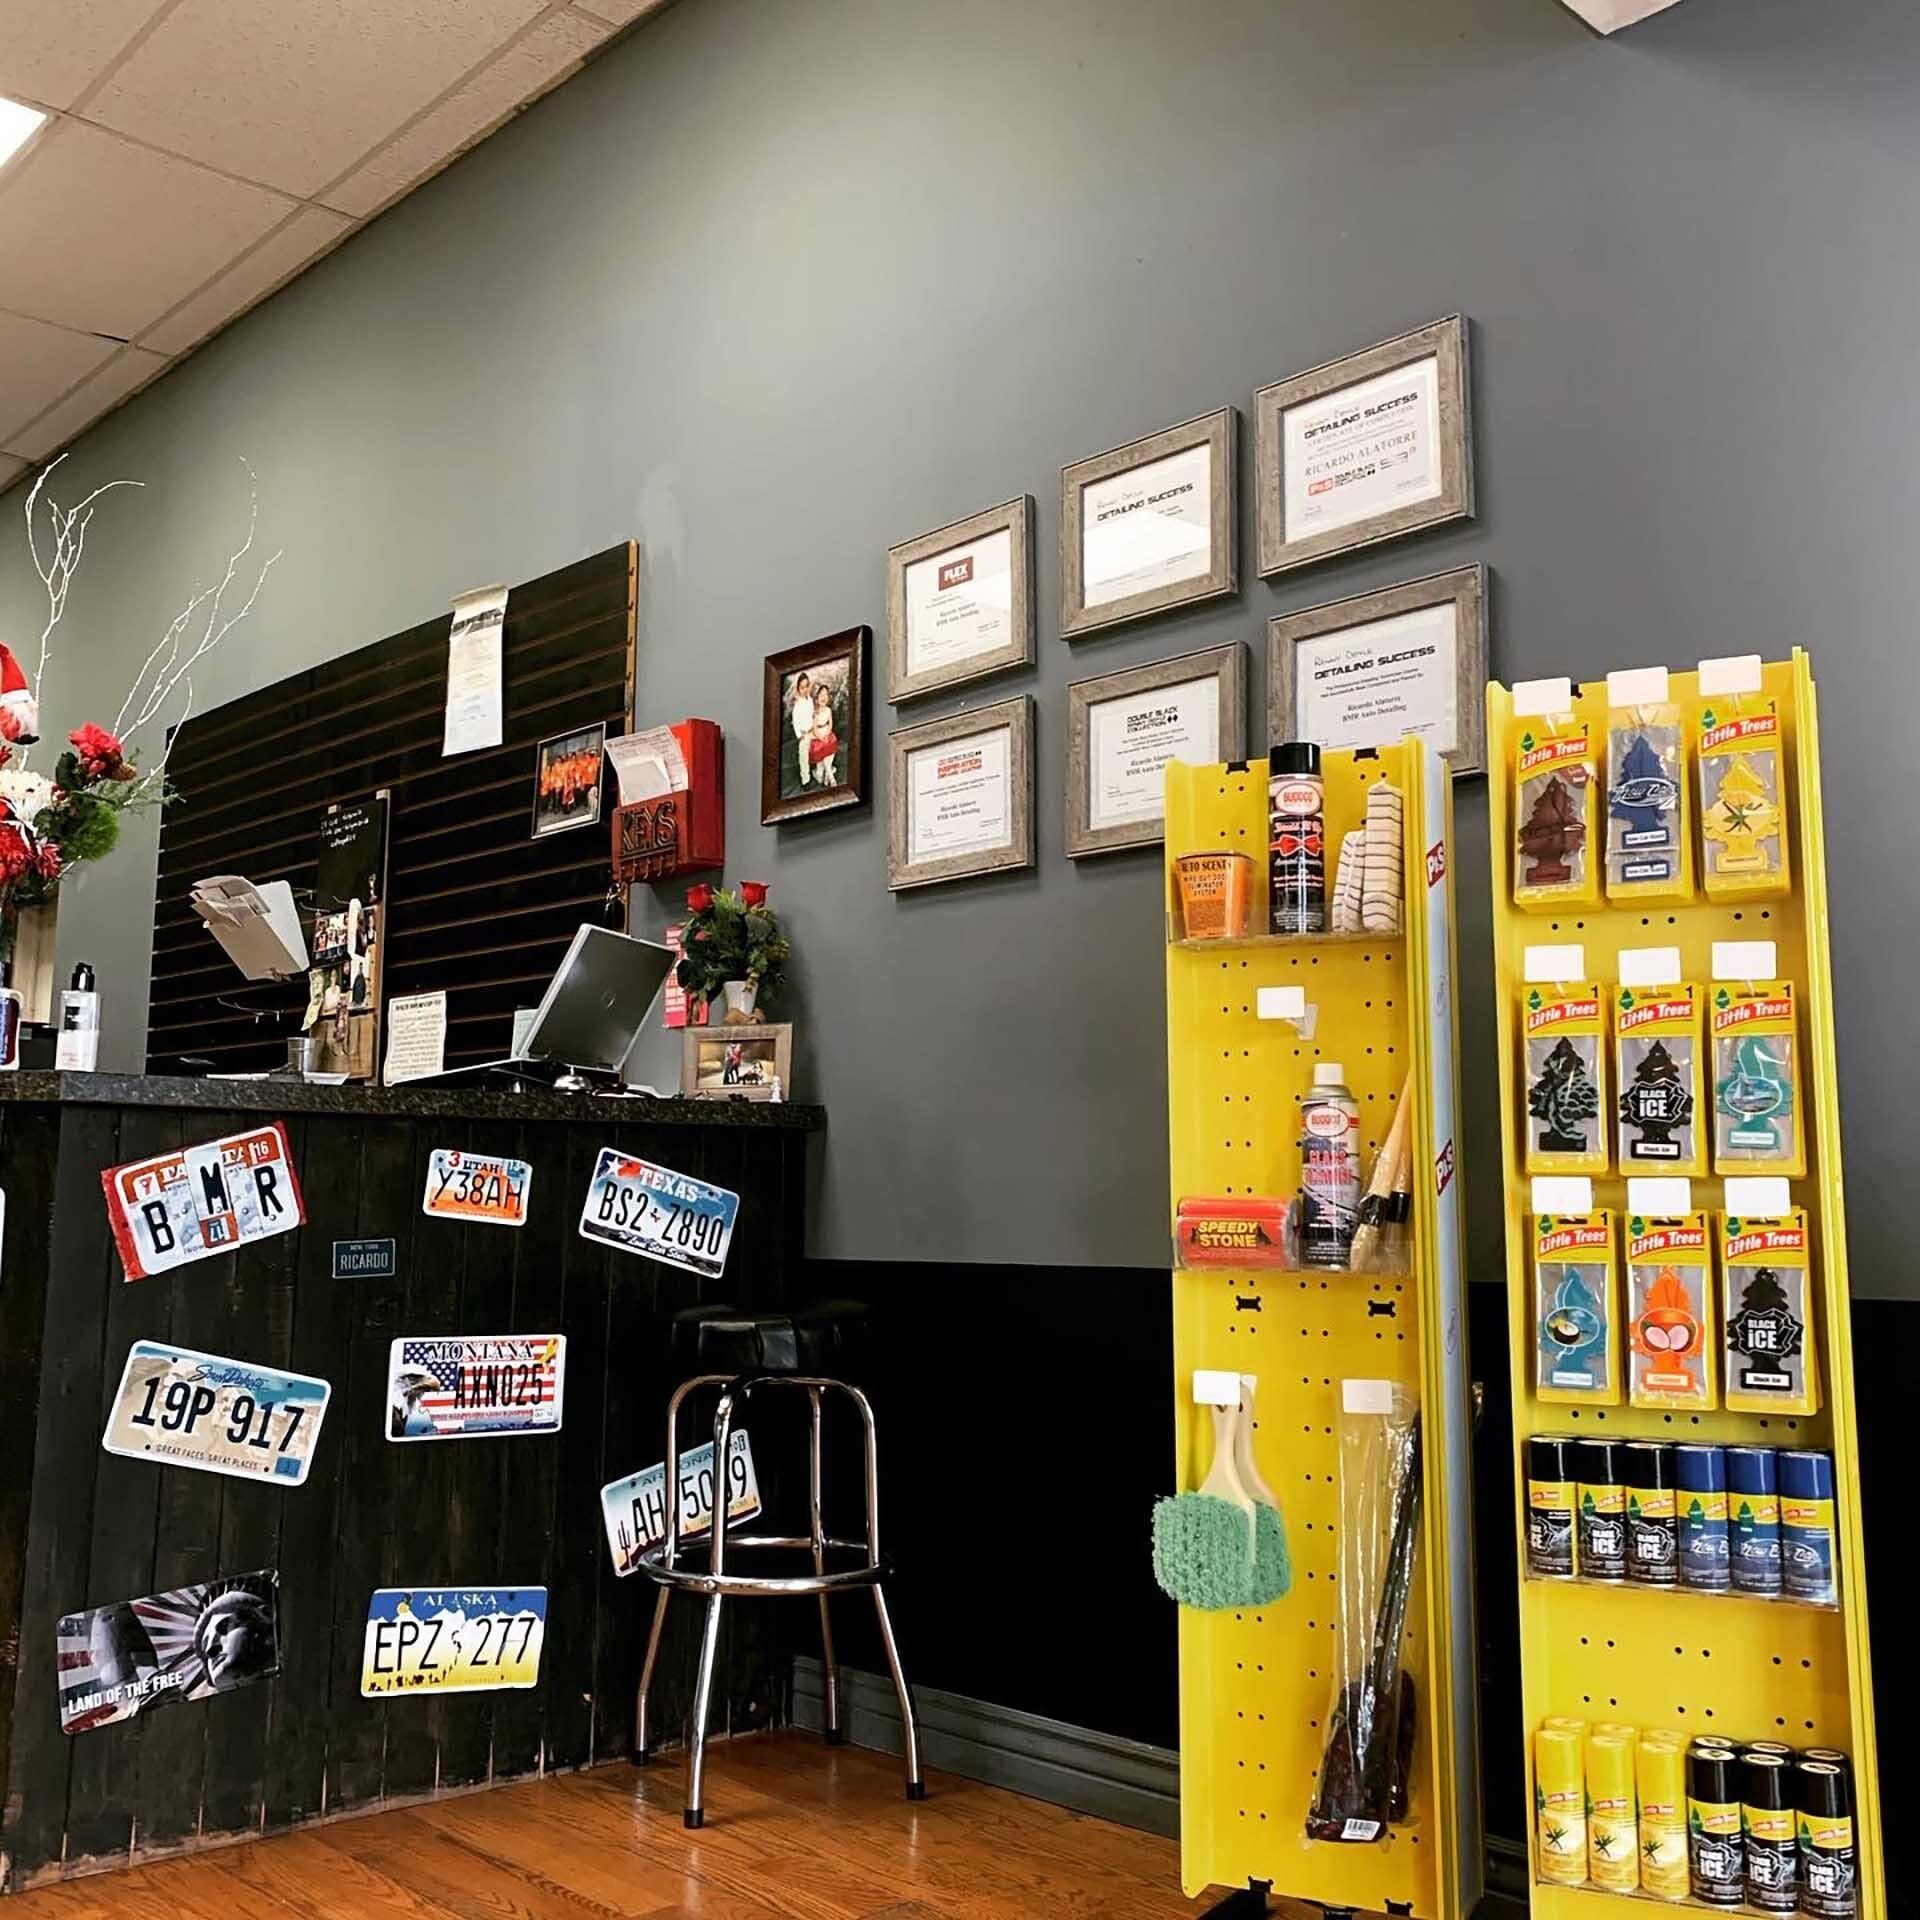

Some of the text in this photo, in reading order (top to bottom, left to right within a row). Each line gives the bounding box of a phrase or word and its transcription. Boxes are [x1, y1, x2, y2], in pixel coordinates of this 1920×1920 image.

[1303, 414, 1361, 440] DETAILING
[1363, 392, 1419, 419] SUCCESS
[1304, 449, 1355, 477] RICARDO
[1358, 430, 1418, 460] ALATORRE
[1097, 499, 1145, 521] DETAILING
[1313, 645, 1436, 681] DETAILING SUCCESS
[1702, 719, 1775, 750] Little Trees
[1520, 741, 1587, 770] Little Trees
[618, 800, 677, 852] KEYS
[1529, 1002, 1598, 1029] Little Trees
[1620, 1003, 1692, 1029] Little Trees
[1716, 1002, 1792, 1029] Little Trees
[1639, 1088, 1668, 1099] BLACK
[254, 1140, 269, 1158] 16
[448, 1151, 460, 1168] 3
[462, 1160, 500, 1174] UTAH
[434, 1166, 523, 1211] Y38AH
[640, 1168, 700, 1202] TEXAS
[141, 1162, 284, 1254] B M R
[598, 1181, 649, 1233] BS2
[1198, 1221, 1259, 1233] SPEEDY
[1199, 1234, 1257, 1248] STONE
[1540, 1228, 1607, 1254] Little Trees
[1631, 1229, 1703, 1257] Little Trees
[1727, 1230, 1801, 1258] Little Trees
[340, 1252, 389, 1270] RICARDO
[1747, 1319, 1777, 1330] BLACK
[427, 1340, 535, 1362] MONTANA
[131, 1376, 305, 1453] 19P 917
[373, 1616, 537, 1674] EPZ 277
[68, 1671, 184, 1714] LAND OF THE FREE
